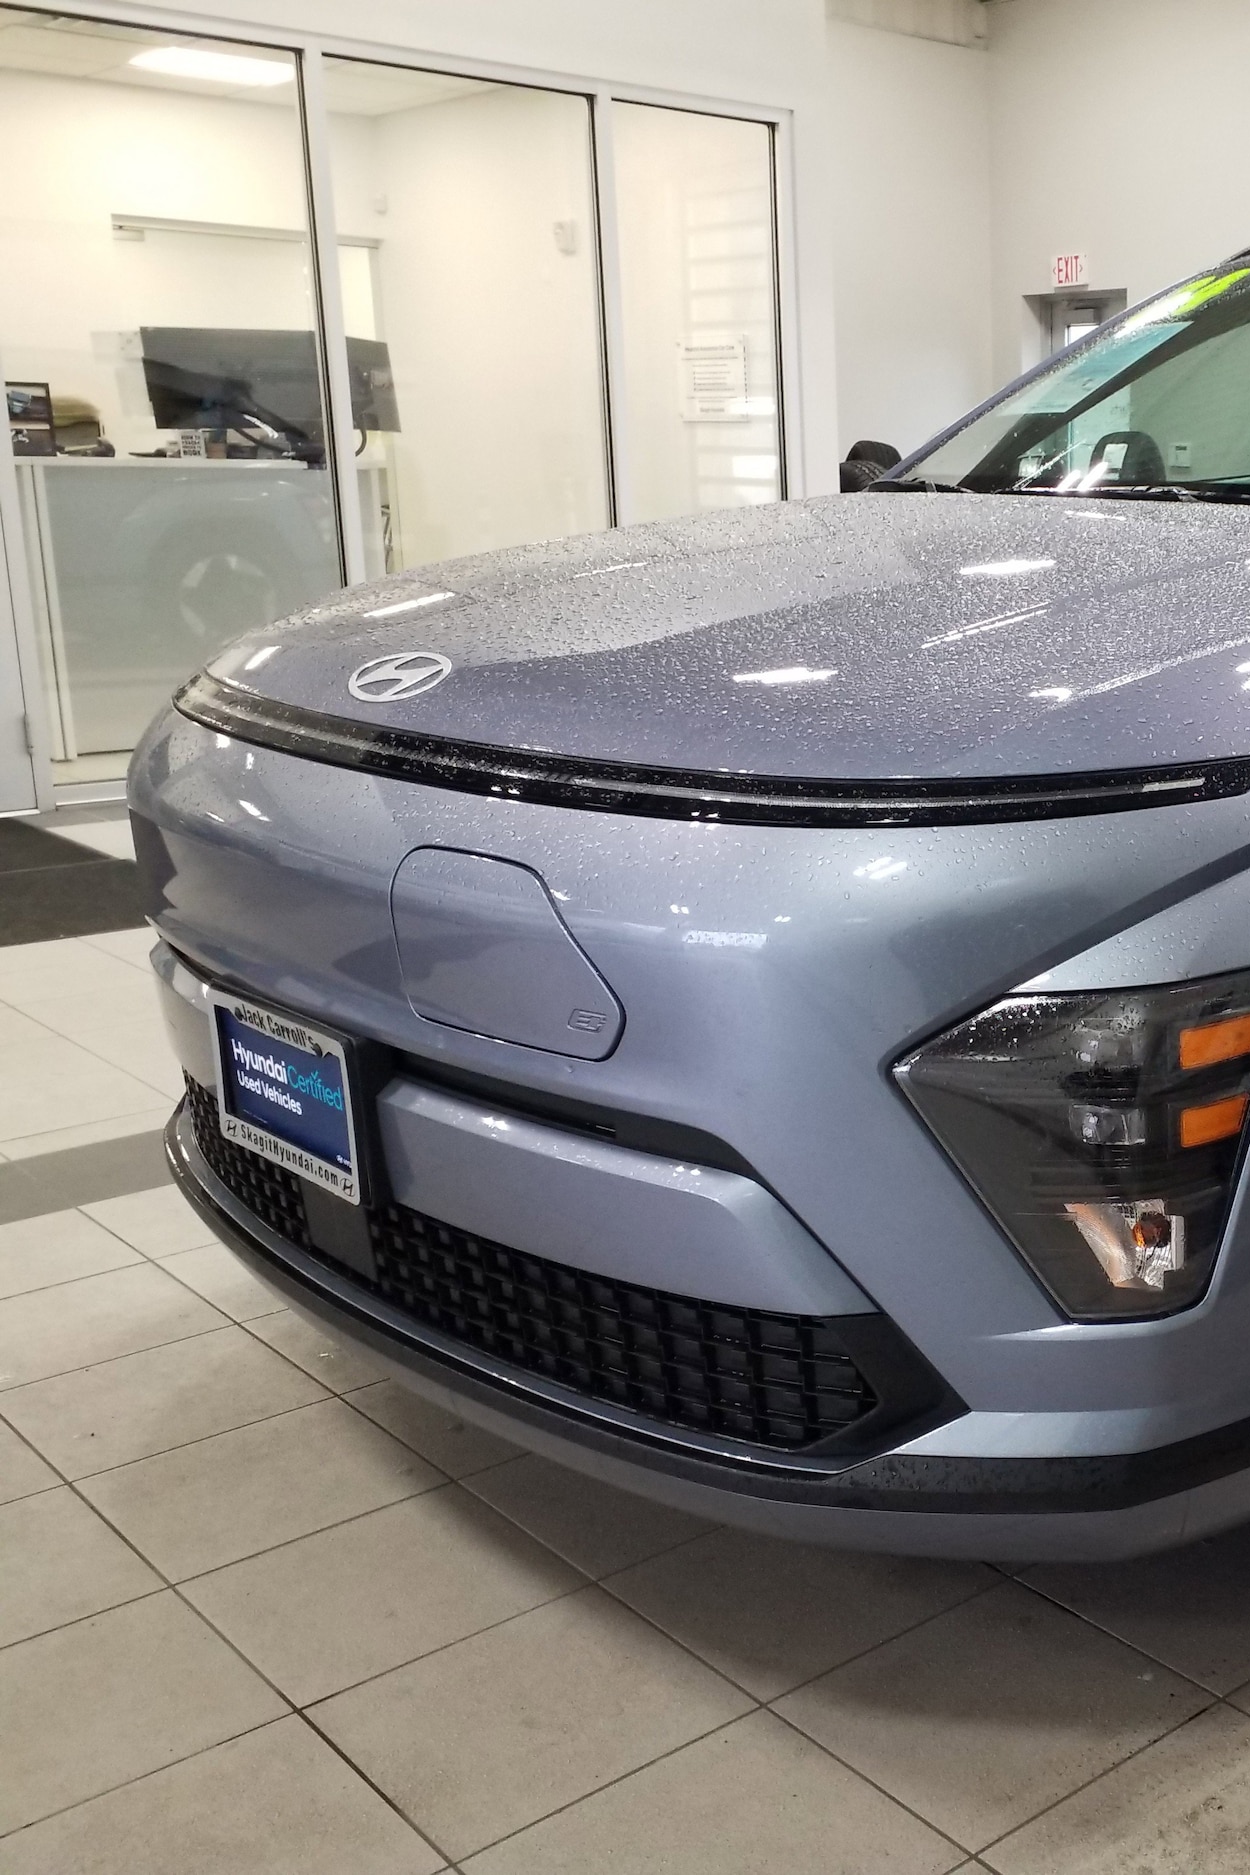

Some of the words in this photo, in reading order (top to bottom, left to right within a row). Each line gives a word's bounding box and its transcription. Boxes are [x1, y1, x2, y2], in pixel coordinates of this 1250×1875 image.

[1057, 255, 1079, 284] EXIT
[239, 1004, 267, 1031] Jack
[267, 1014, 317, 1050] Carroll's
[231, 1038, 288, 1085] Hyundai
[287, 1065, 343, 1111] Certified
[237, 1070, 262, 1095] Used
[261, 1080, 303, 1115] Vehicles
[241, 1124, 339, 1187] SkagitHyundai.com
